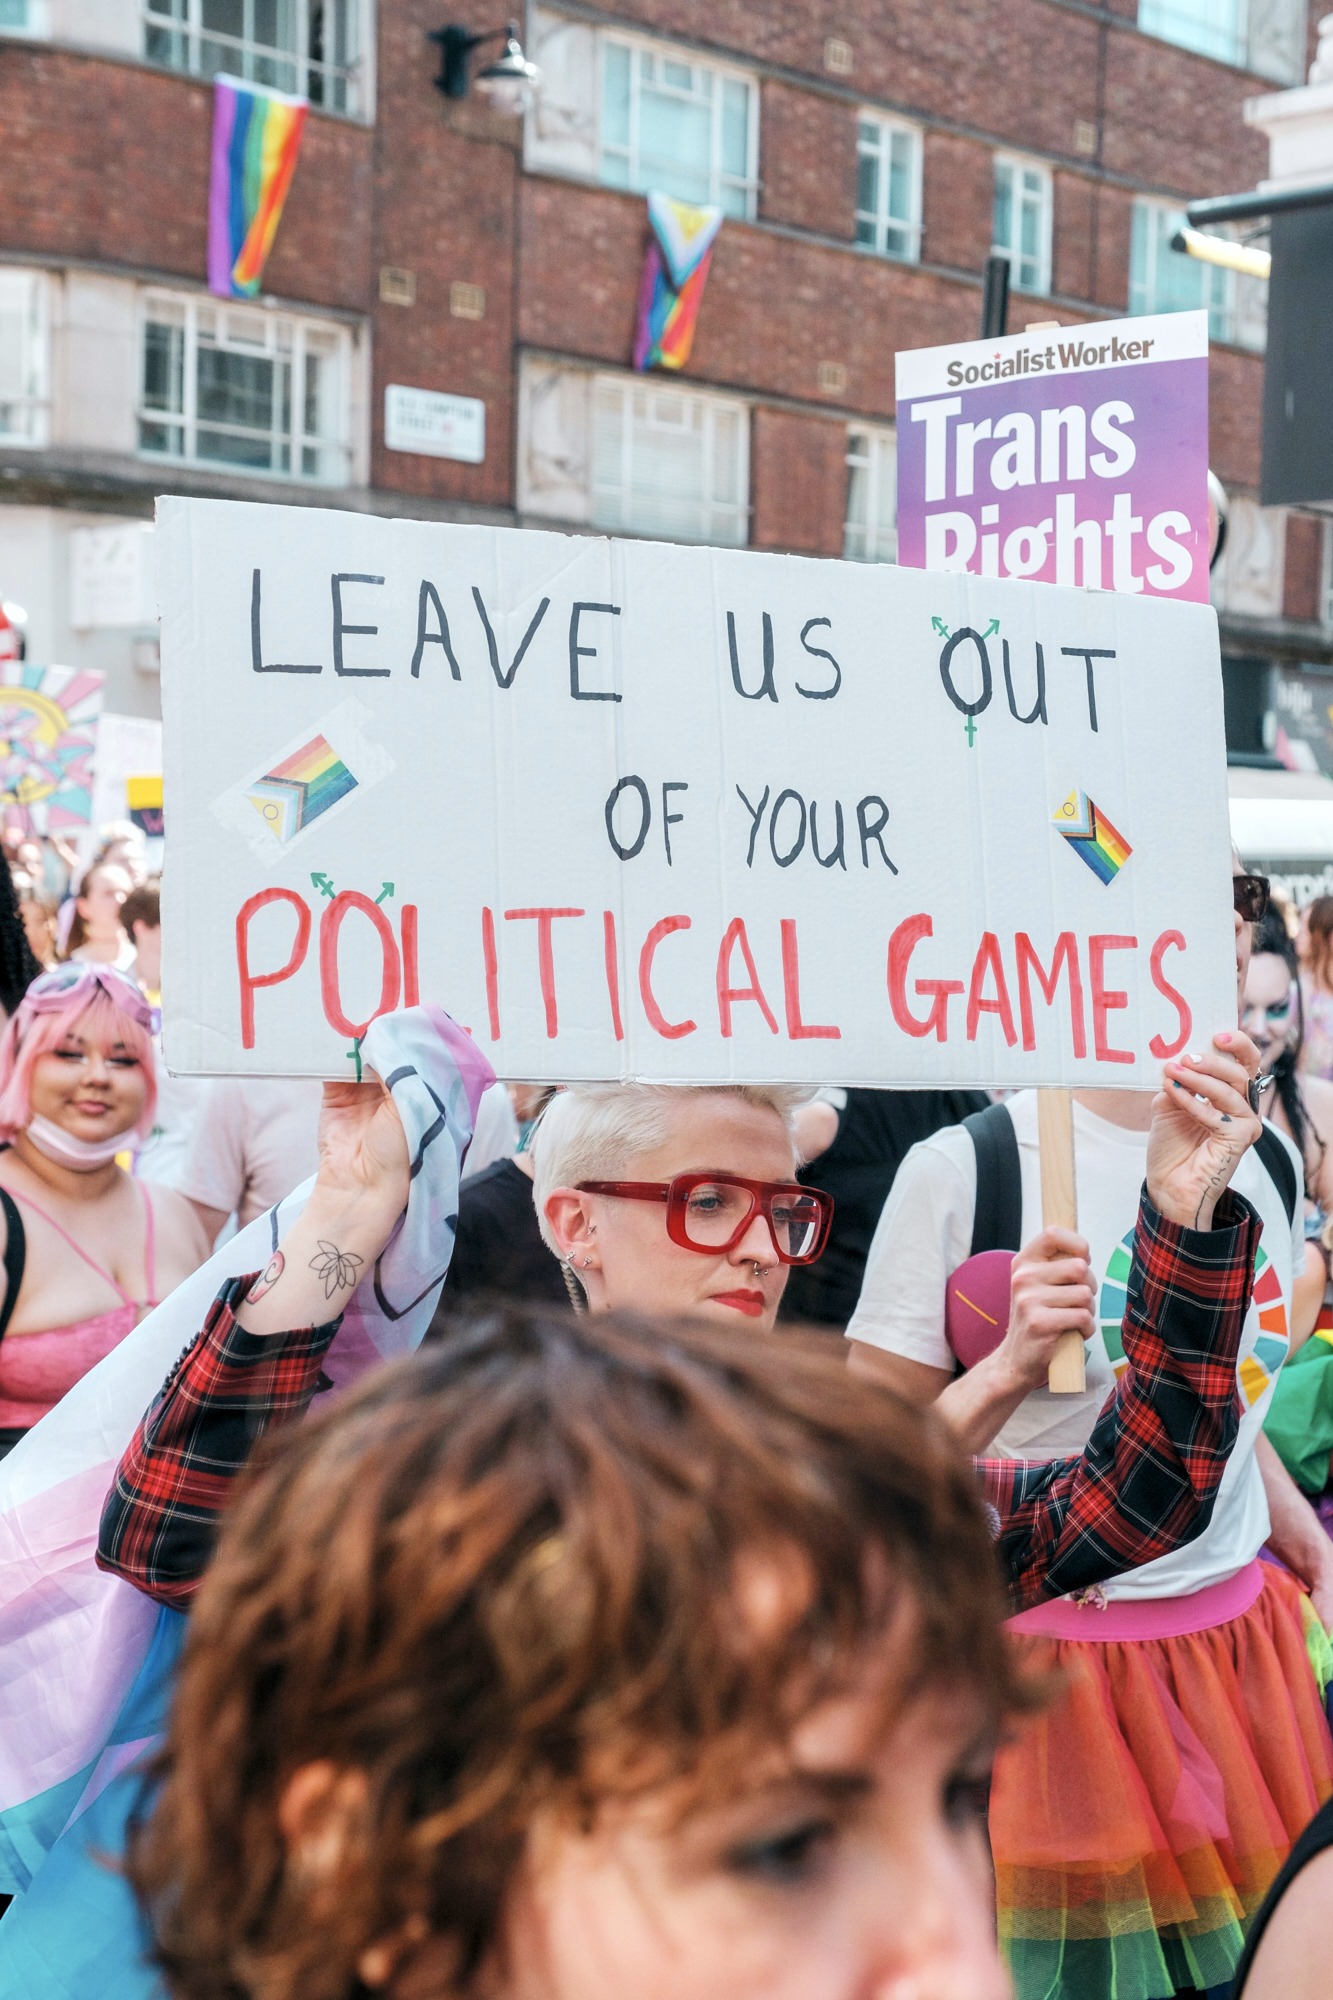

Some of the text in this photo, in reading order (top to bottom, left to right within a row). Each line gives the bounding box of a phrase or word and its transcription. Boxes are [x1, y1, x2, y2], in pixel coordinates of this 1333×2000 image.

[910, 396, 1137, 503] Trans
[925, 492, 1194, 594] Rights
[251, 568, 1117, 733] LEAVE US OUT
[604, 774, 899, 876] OF YOUR
[235, 887, 1193, 1064] POLITICAL GAMES
